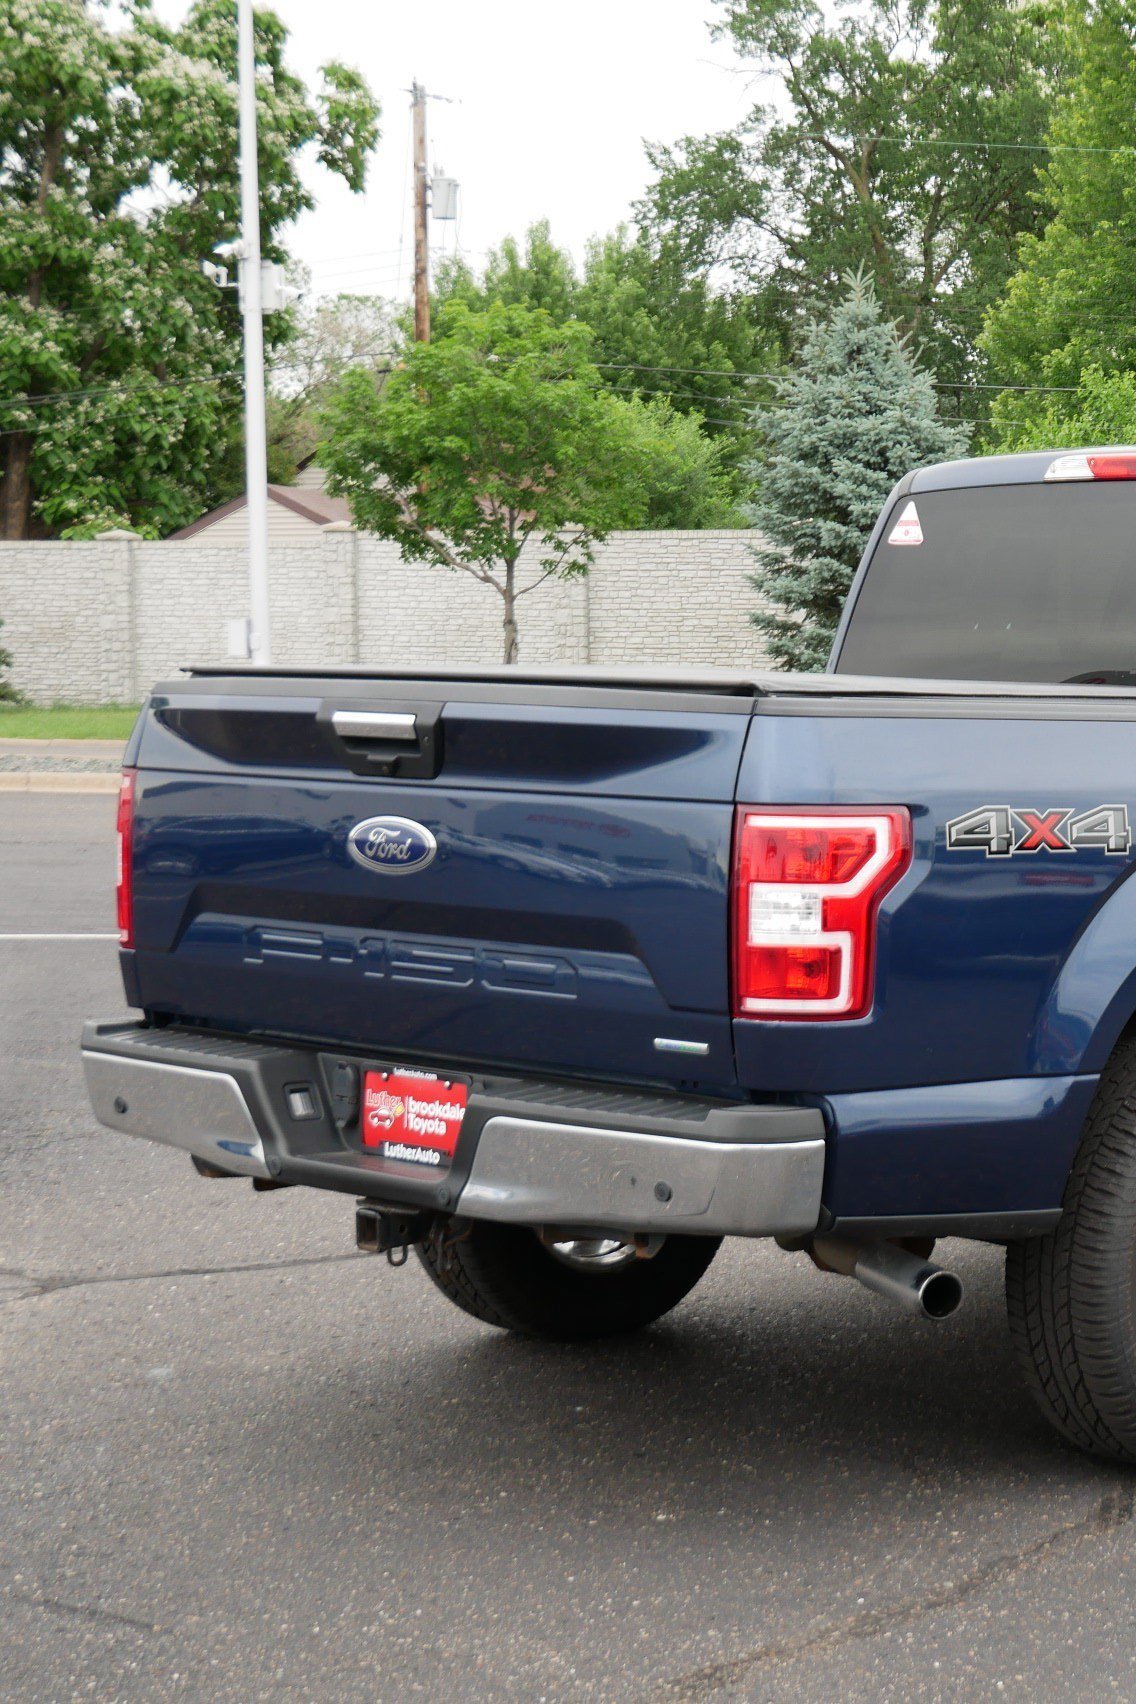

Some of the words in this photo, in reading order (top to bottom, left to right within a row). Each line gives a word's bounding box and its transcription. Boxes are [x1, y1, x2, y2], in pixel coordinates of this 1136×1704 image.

[363, 826, 412, 861] Ford
[243, 924, 578, 999] F-150
[408, 1113, 447, 1135] Toyota
[385, 1142, 441, 1165] LutherAuto
